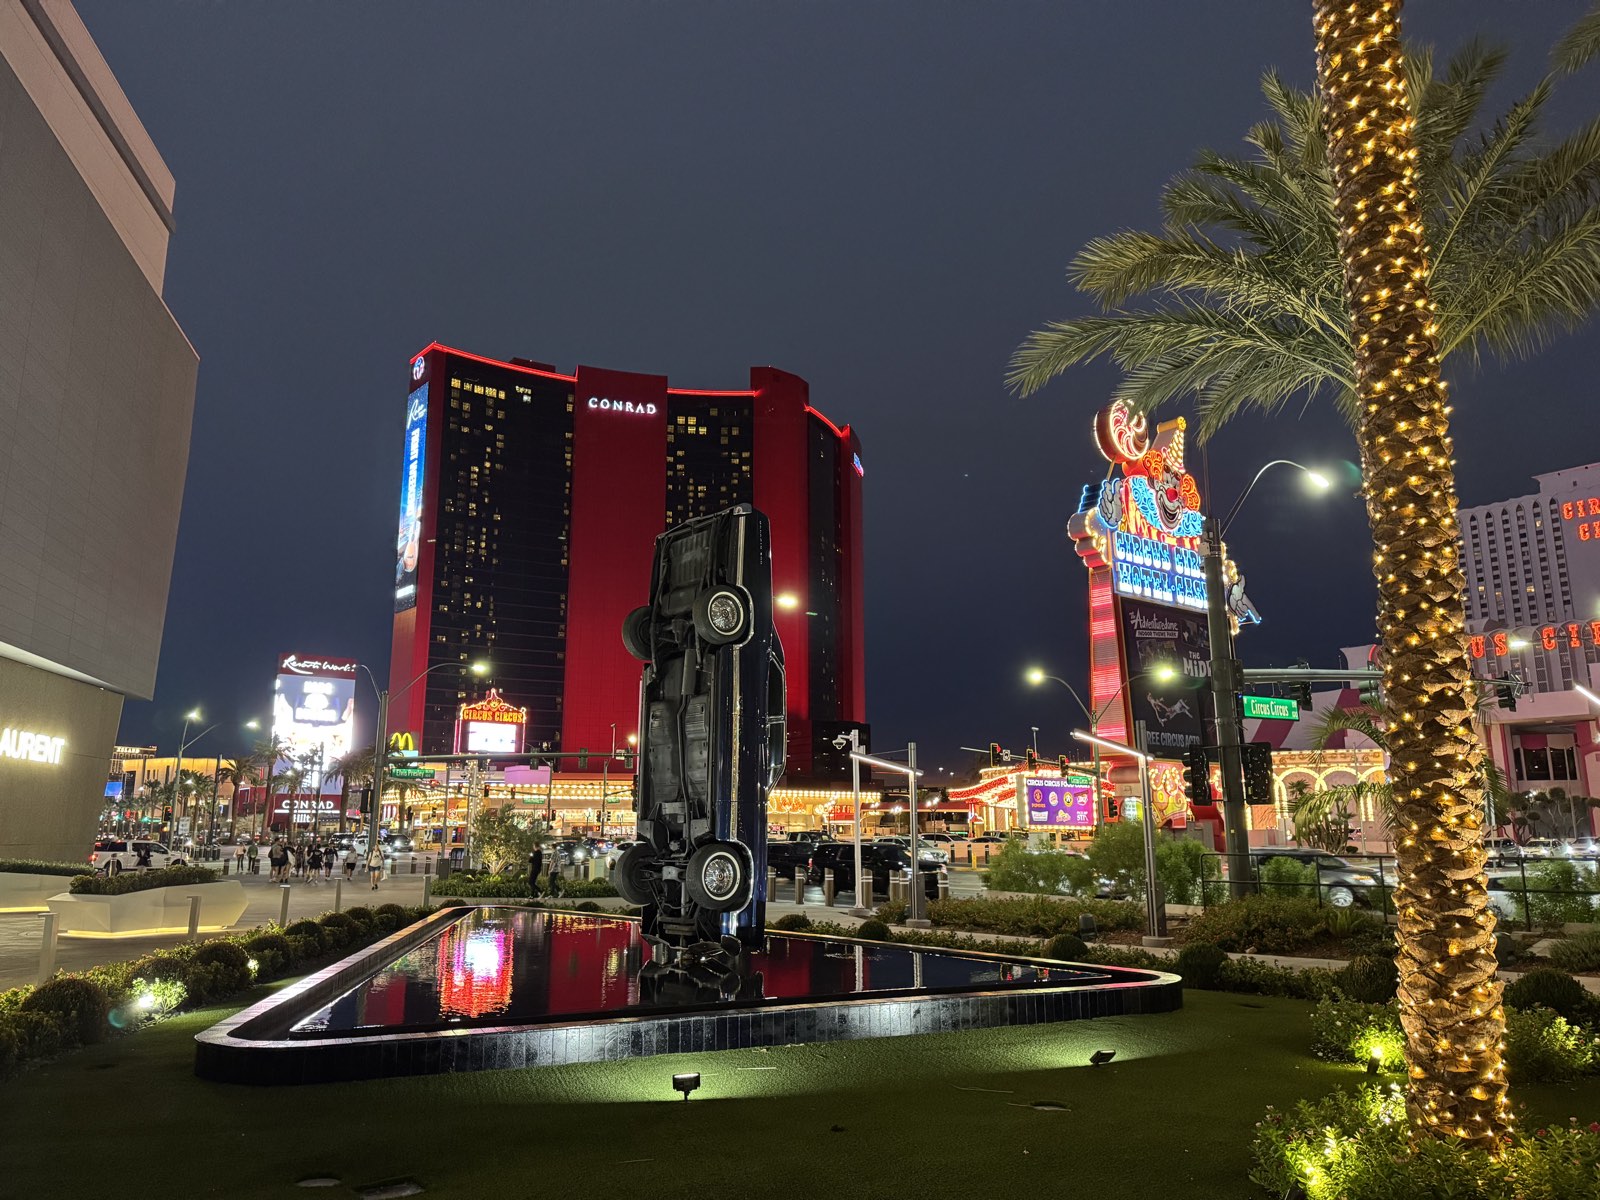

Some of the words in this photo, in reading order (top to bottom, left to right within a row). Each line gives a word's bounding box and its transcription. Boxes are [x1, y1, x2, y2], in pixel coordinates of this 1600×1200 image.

[588, 397, 657, 415] CONRAD
[1115, 531, 1172, 571] CIRCUS
[1174, 546, 1206, 580] CIR
[1130, 607, 1179, 631] Adventuredome
[1188, 650, 1201, 660] THE
[463, 709, 493, 721] CIRCUS
[494, 710, 523, 723] CIRCUS
[1251, 699, 1270, 715] Circus
[1270, 700, 1289, 717] Circus
[1146, 731, 1160, 745] REE
[1160, 732, 1185, 747] CIRCUS
[1026, 779, 1044, 787] CIRCUS
[1044, 780, 1061, 788] CIRCUS
